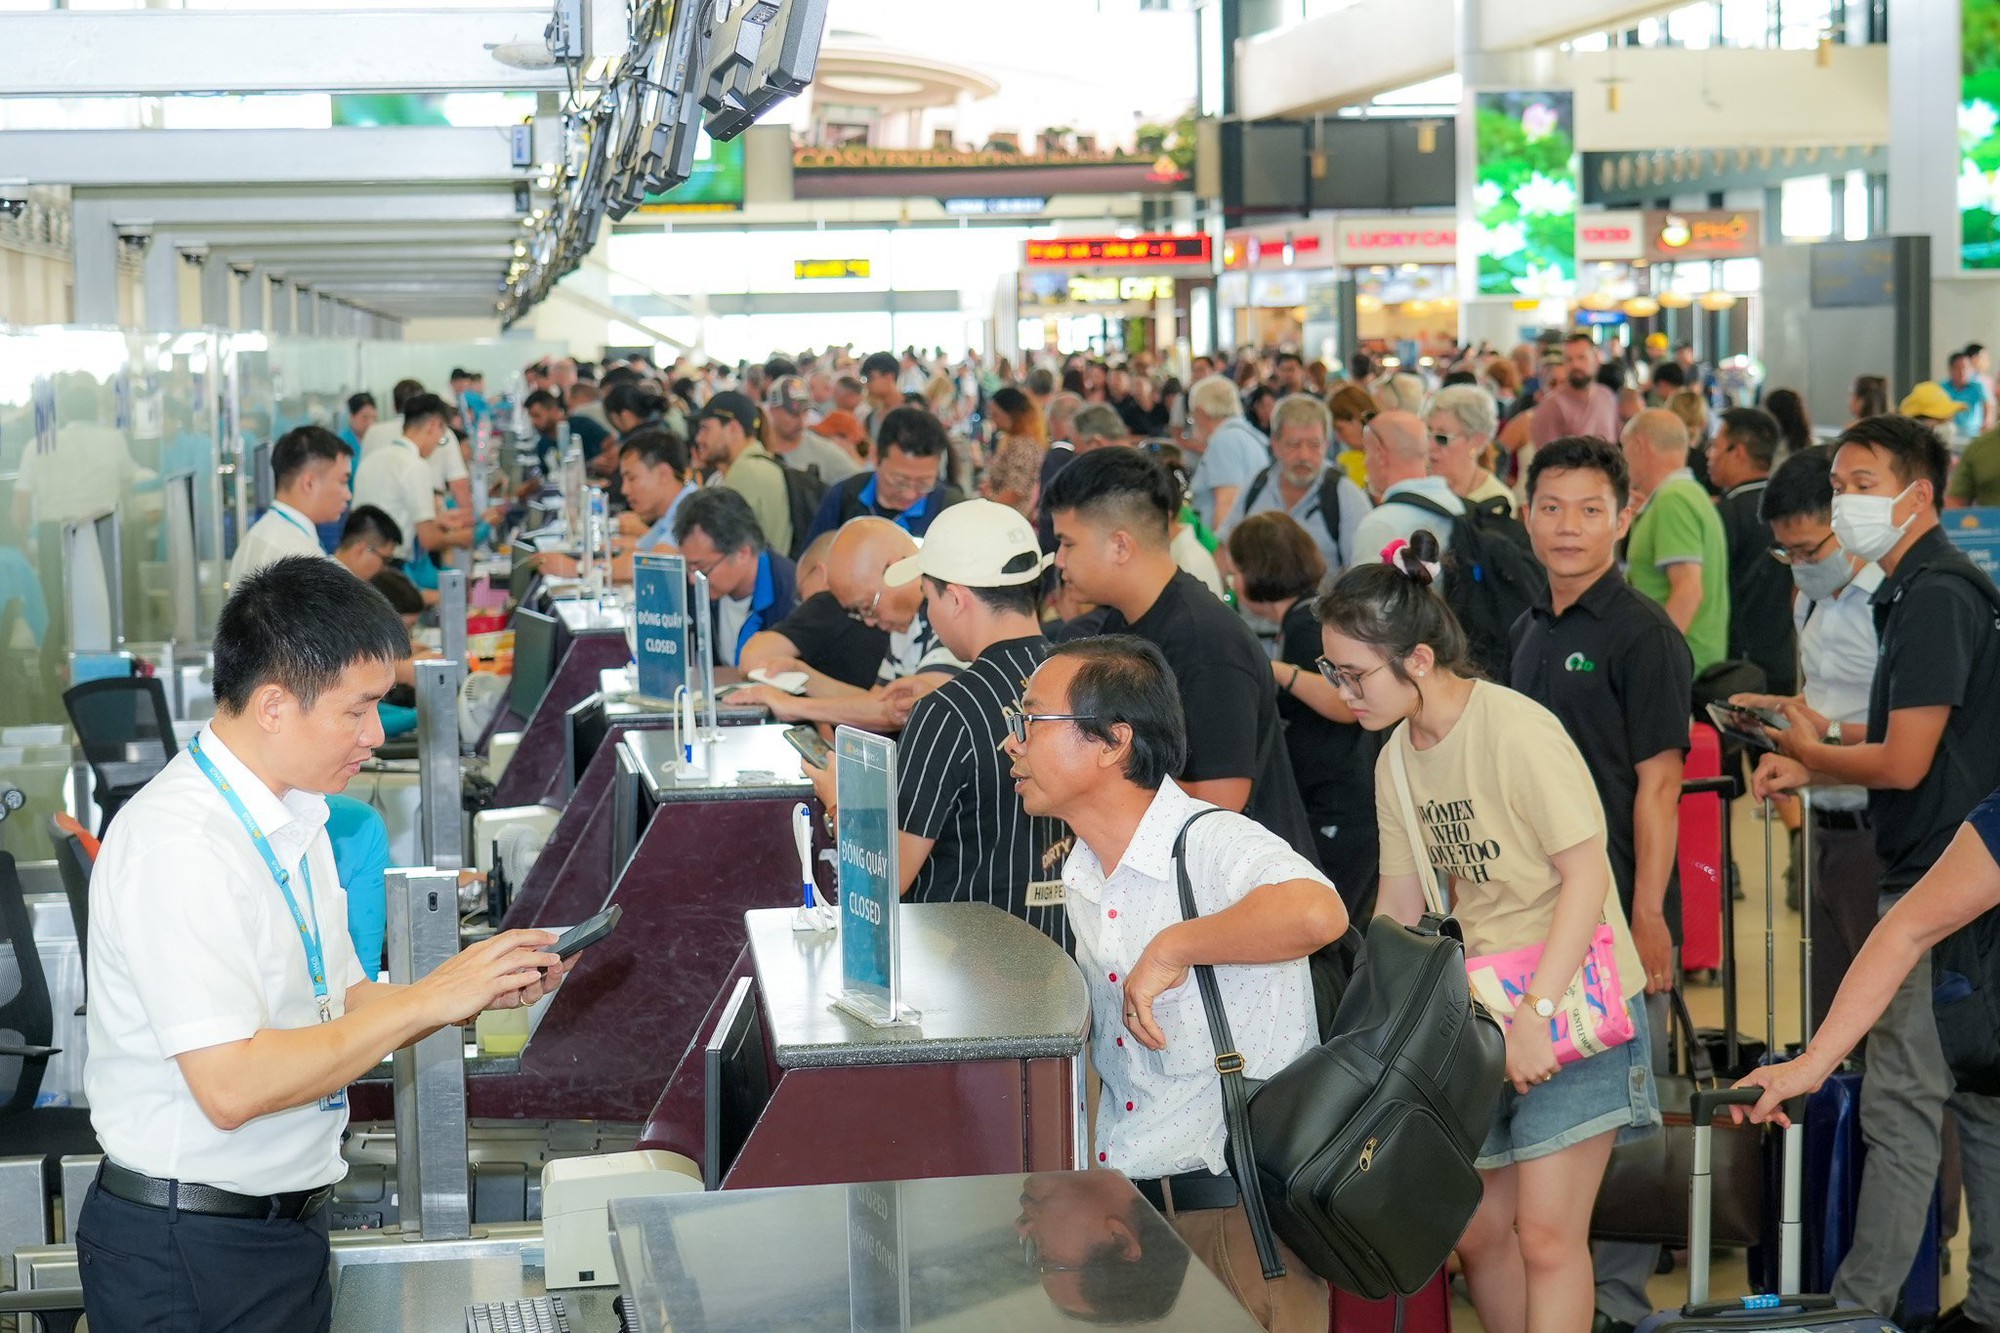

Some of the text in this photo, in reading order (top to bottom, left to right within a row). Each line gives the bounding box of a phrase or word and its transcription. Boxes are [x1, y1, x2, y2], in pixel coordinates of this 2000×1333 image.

[645, 638, 677, 655] CLOSED
[1418, 799, 1475, 824] WOMEN
[1430, 822, 1470, 844] WHO
[842, 839, 864, 869] ĐÓNG
[849, 891, 880, 925] CLOSED
